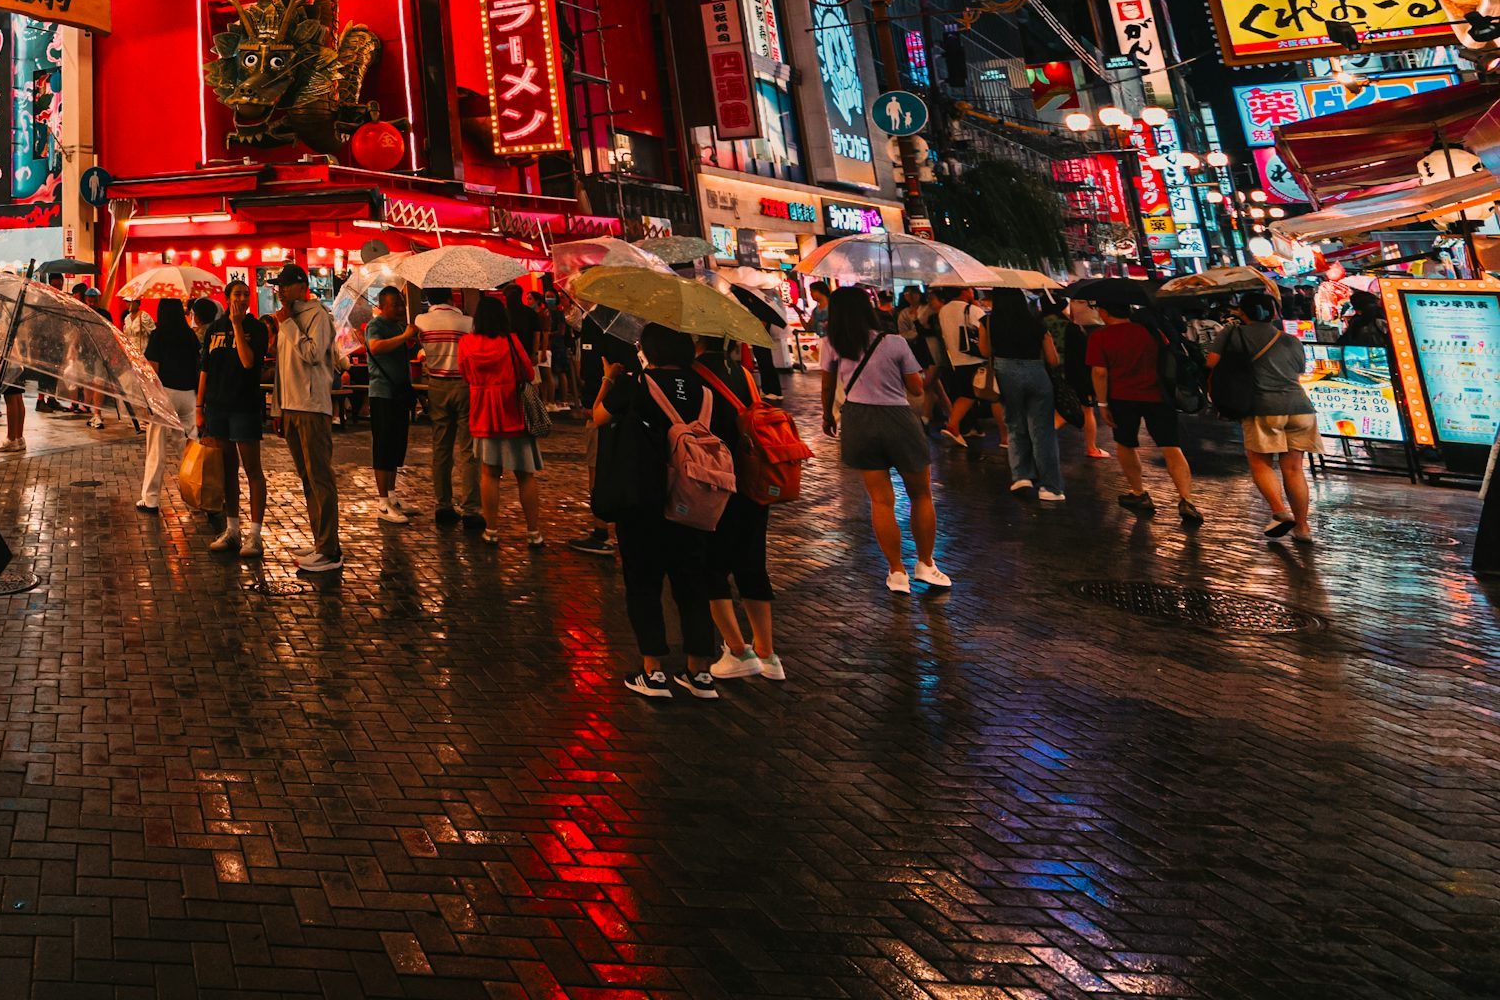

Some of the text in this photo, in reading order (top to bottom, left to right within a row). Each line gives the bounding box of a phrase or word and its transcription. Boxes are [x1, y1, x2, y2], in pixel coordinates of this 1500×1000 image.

[712, 2, 731, 43] 回転寿司
[1277, 37, 1319, 48] 大阪名物
[1249, 86, 1301, 126] 薬
[831, 127, 871, 163] ジャンカラ
